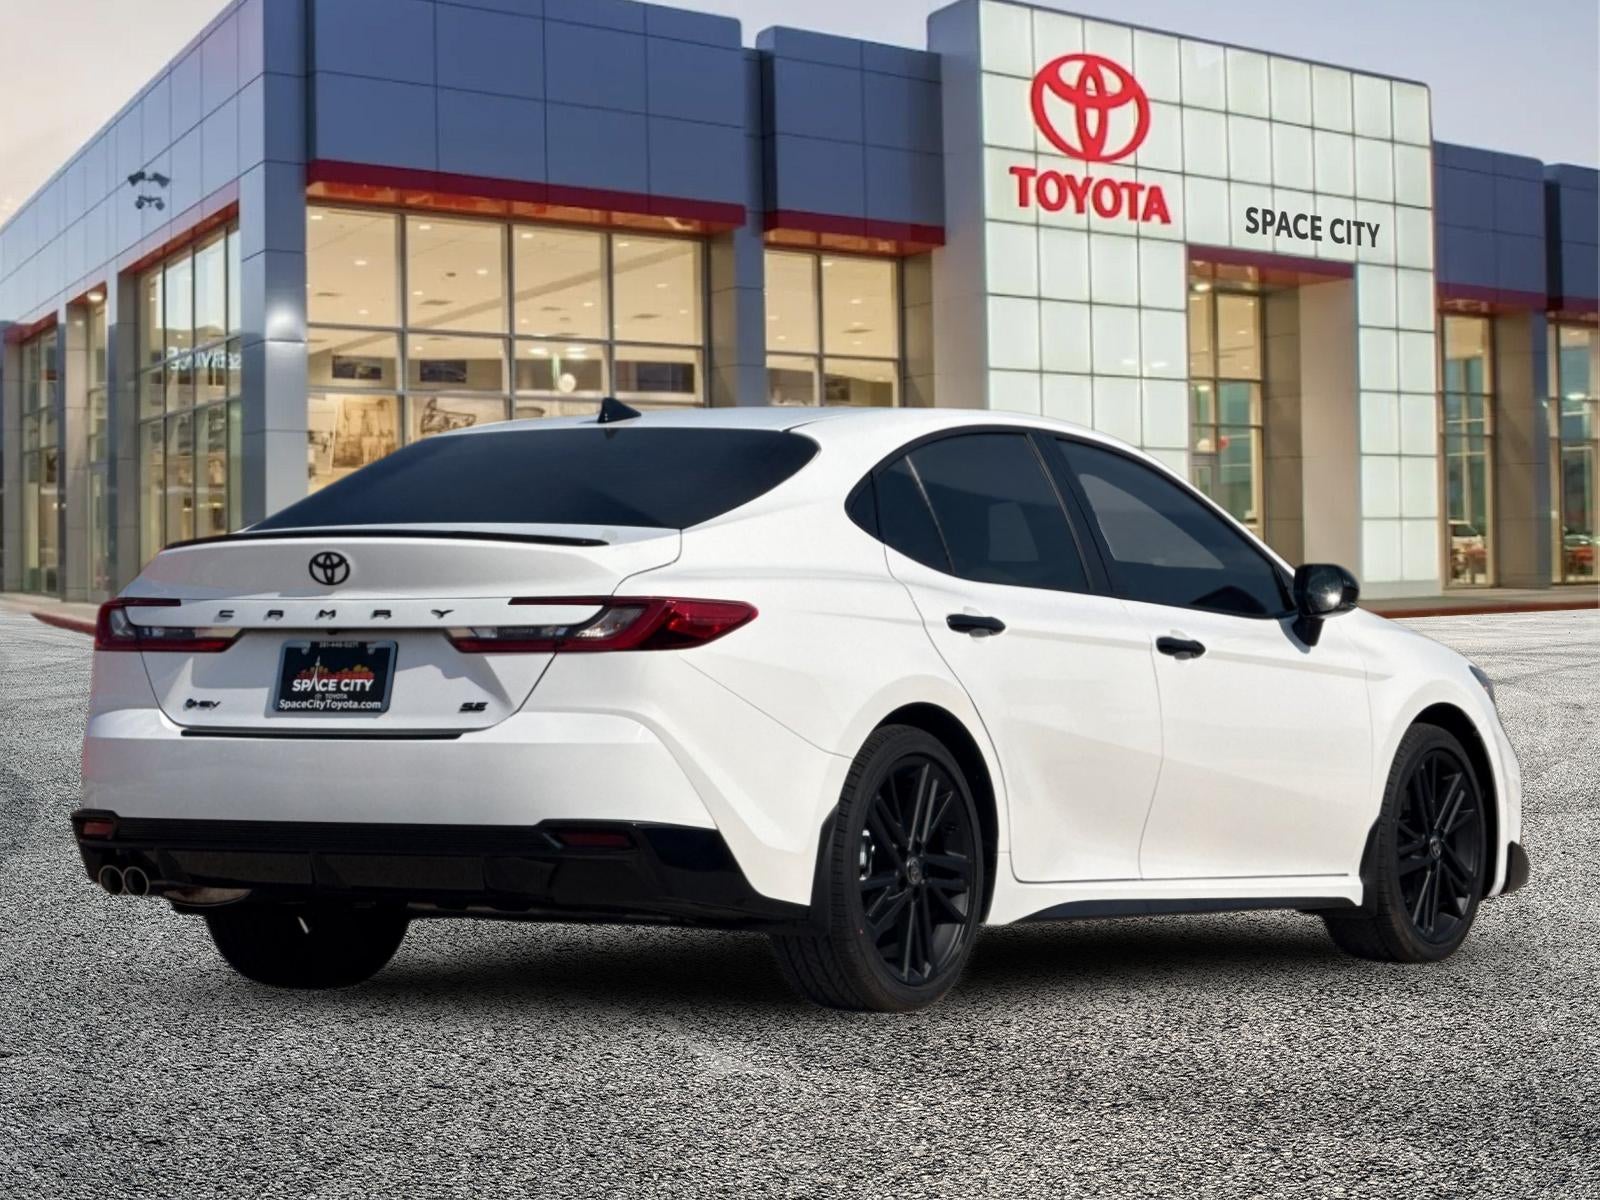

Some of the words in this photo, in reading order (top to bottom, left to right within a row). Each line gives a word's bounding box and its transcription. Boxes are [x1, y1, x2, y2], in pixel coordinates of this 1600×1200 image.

[1008, 166, 1171, 224] TOYOTA
[1245, 206, 1322, 241] SPACE
[1329, 218, 1380, 248] CITY
[217, 609, 454, 619] CAMRY
[291, 679, 337, 692] SPACE
[340, 679, 375, 692] CITY
[279, 699, 382, 710] SpaceCityToyota.com
[459, 702, 488, 712] SE
